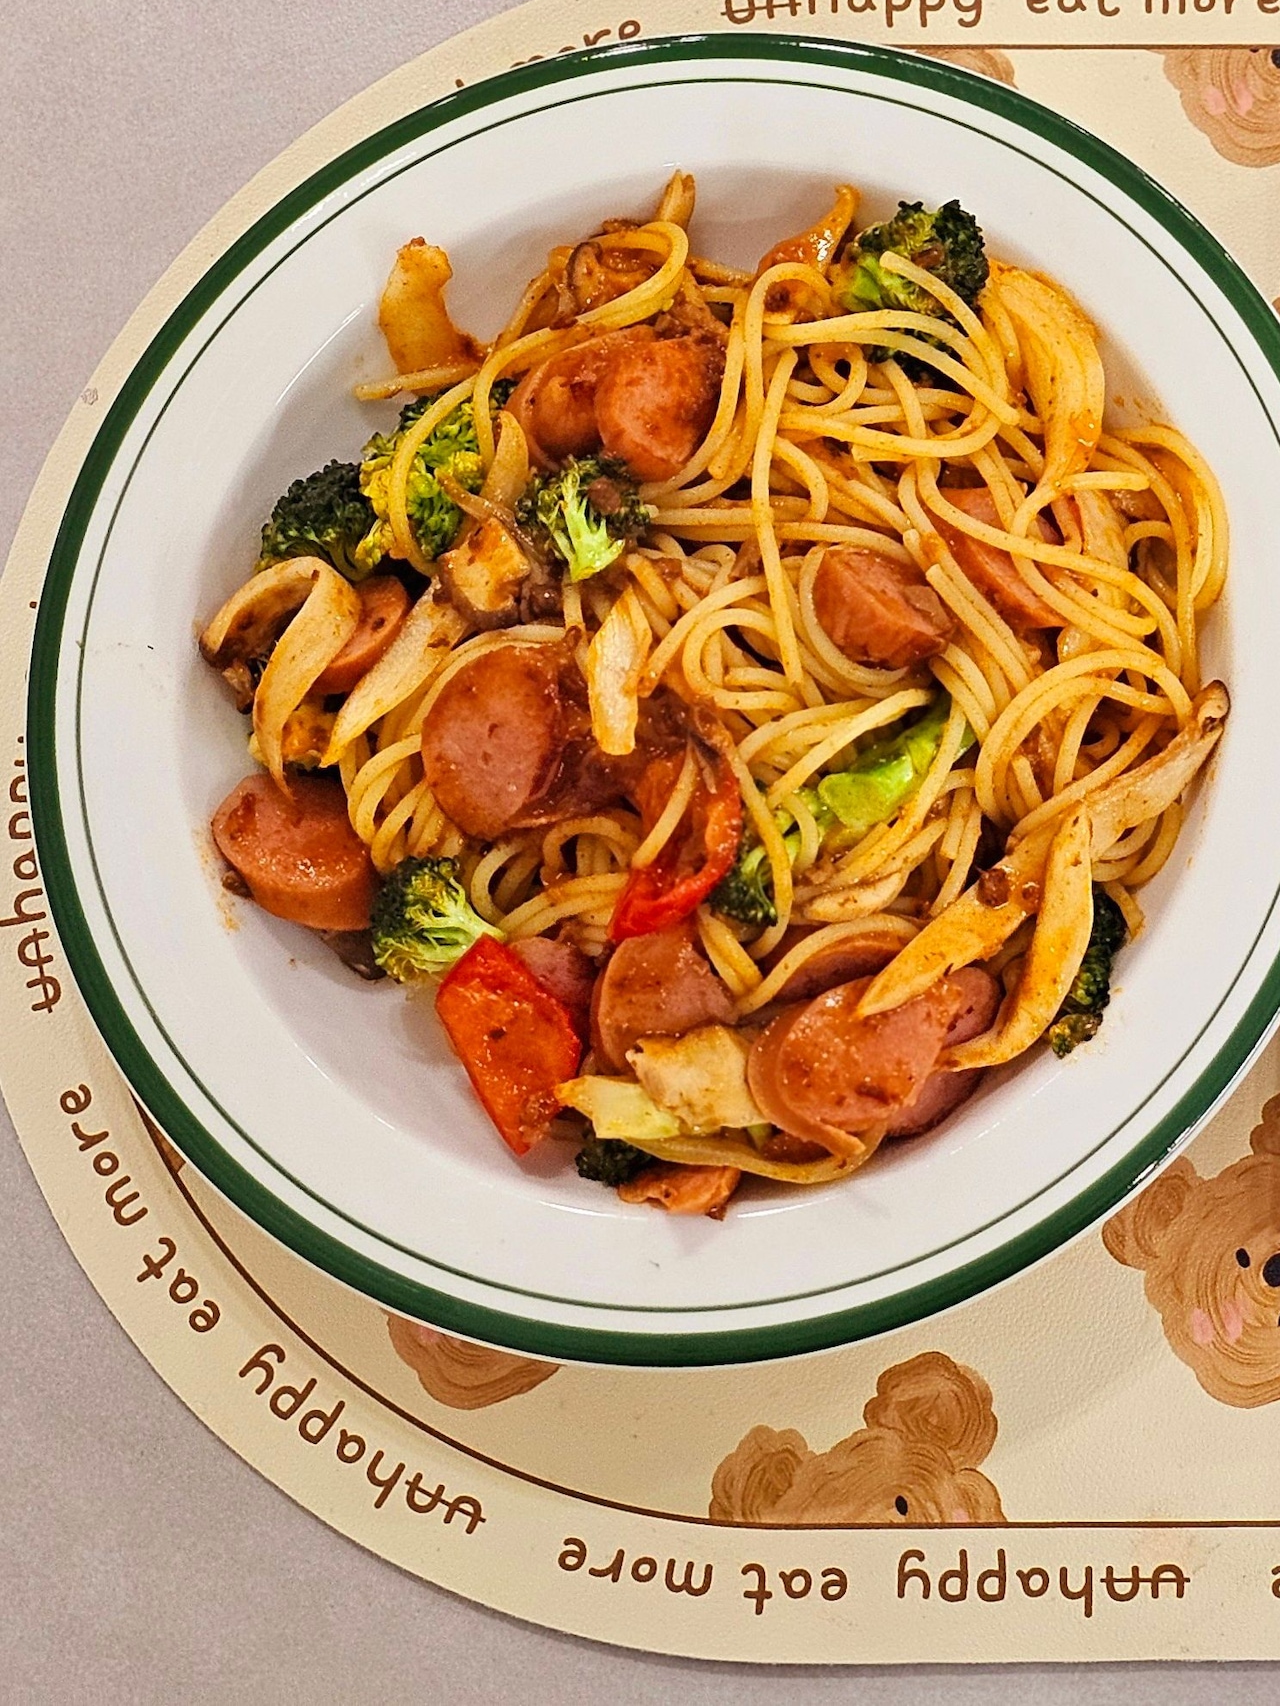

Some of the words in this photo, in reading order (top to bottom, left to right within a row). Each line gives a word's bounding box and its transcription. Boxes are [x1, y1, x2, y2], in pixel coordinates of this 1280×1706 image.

[0, 734, 62, 1013] unha
[59, 1083, 149, 1227] more
[136, 1236, 221, 1333] eat
[238, 1343, 487, 1535] unhappy
[557, 1537, 714, 1597] more
[740, 1562, 848, 1616] eat
[897, 1548, 1191, 1619] unhappy
